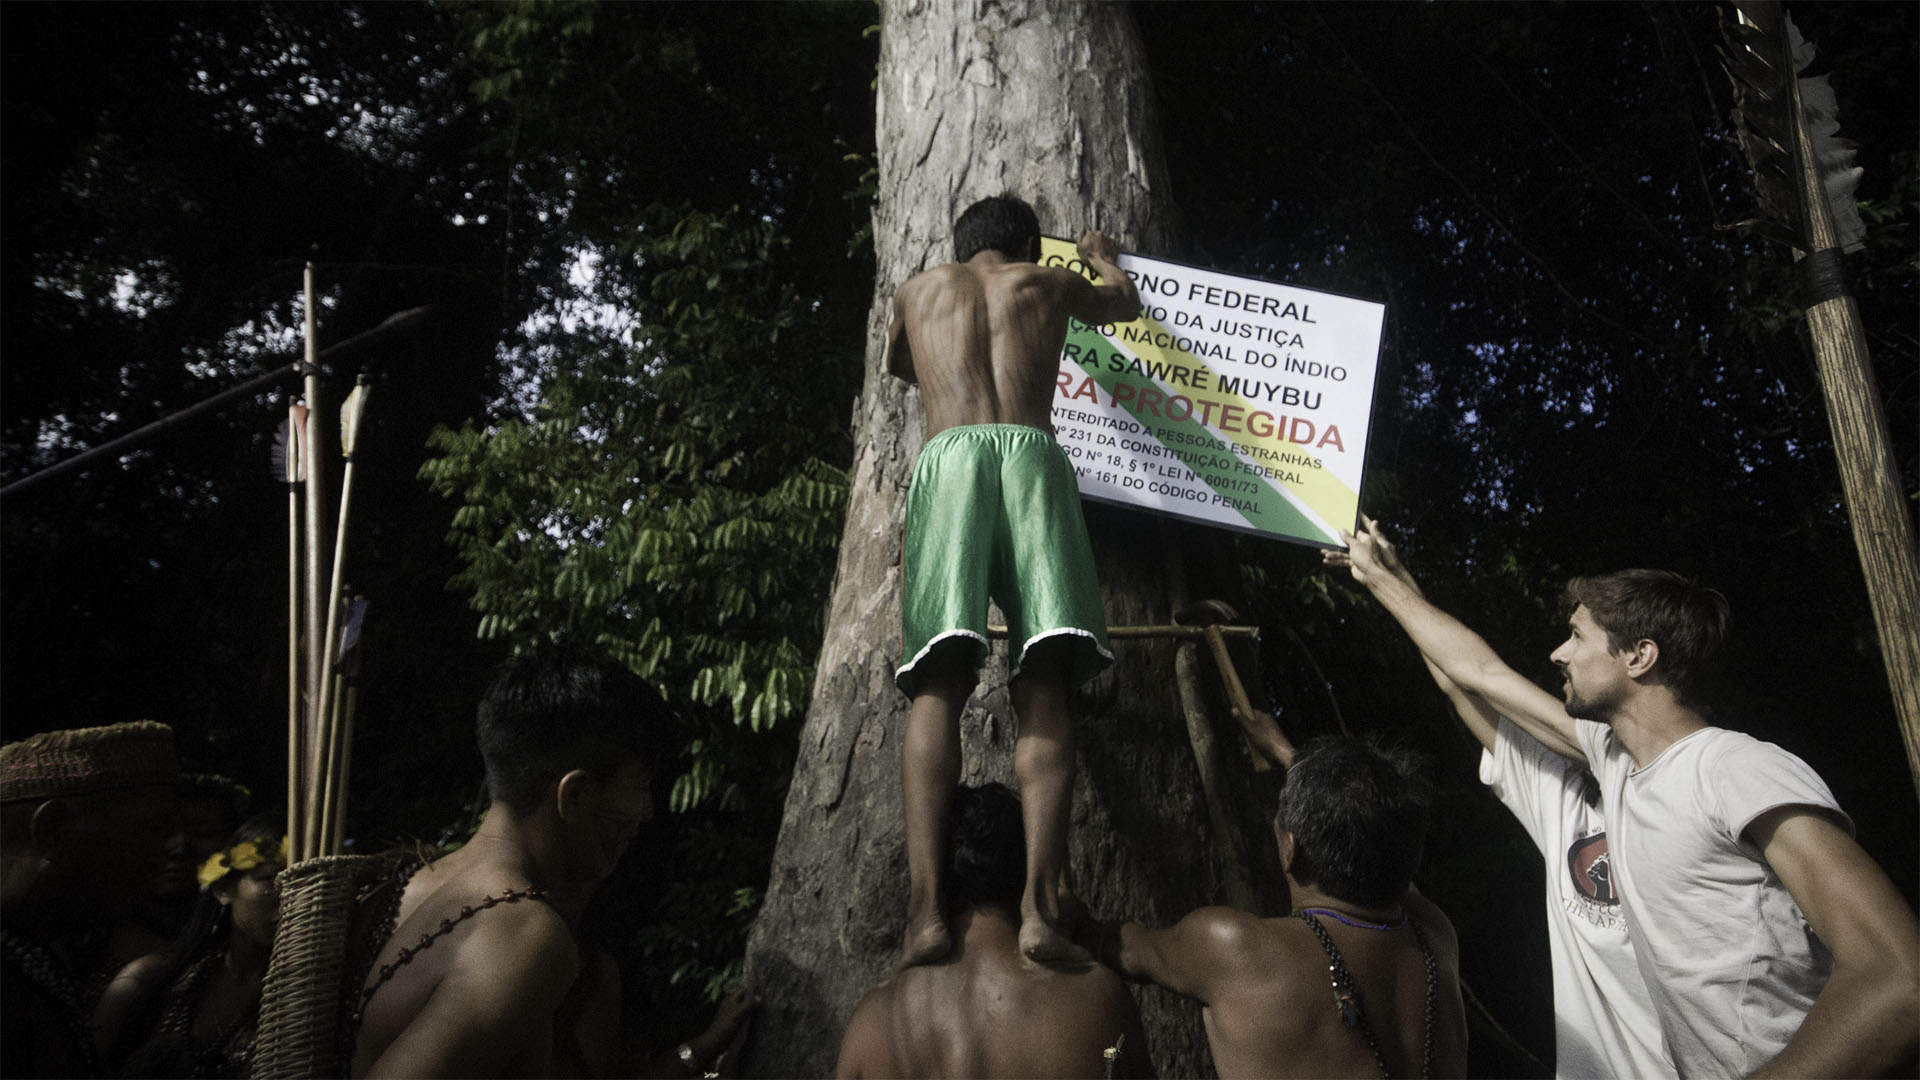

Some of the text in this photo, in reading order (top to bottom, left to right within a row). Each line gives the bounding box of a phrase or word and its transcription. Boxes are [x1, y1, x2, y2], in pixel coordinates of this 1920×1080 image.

[1188, 283, 1318, 324] FEDERAL
[1174, 310, 1203, 330] DA
[1210, 318, 1305, 349] JUSTIÇA
[1123, 327, 1238, 361] NACIONAL
[1244, 350, 1277, 369] DO
[1284, 352, 1347, 382] ÍNDIO
[1108, 352, 1211, 390] SAWRÉ
[1217, 374, 1322, 410] MUYBU
[1110, 382, 1345, 453] PROTEGIDA
[1069, 428, 1092, 442] 231
[1096, 434, 1117, 448] DA
[1120, 438, 1231, 471] CONSTITUIÇÃO
[1234, 462, 1305, 485] FEDERAL
[1142, 424, 1153, 437] A
[1156, 429, 1226, 452] PESSOAS
[1230, 443, 1323, 470] ESTRANHAS
[1096, 470, 1118, 485] 161
[1122, 476, 1144, 490] DO
[1148, 475, 1207, 503] CÓDIGO
[1211, 494, 1263, 514] PENAL
[1106, 453, 1125, 468] 18,
[1128, 458, 1138, 473] §
[1158, 465, 1182, 480] LEI
[1205, 473, 1259, 494] 6001/73
